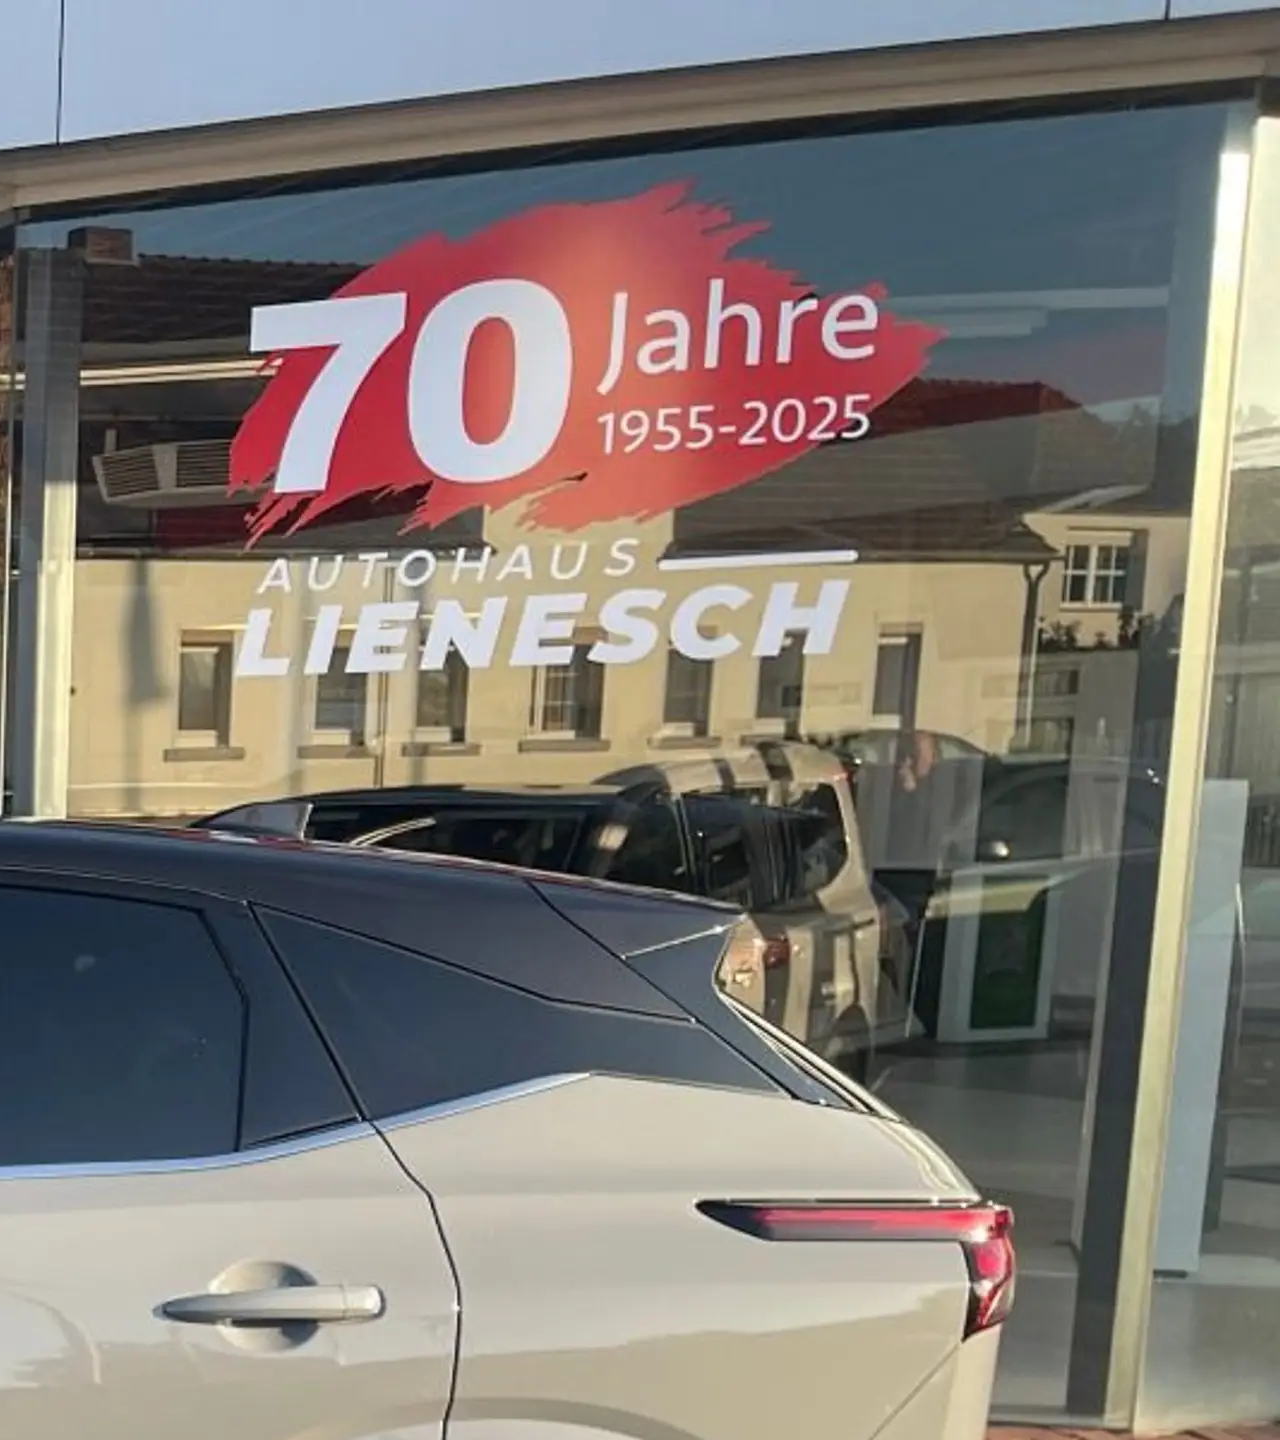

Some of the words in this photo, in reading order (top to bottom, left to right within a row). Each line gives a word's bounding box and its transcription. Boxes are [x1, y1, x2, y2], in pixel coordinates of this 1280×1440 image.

[250, 278, 572, 494] 70
[595, 278, 880, 396] Jahre
[596, 394, 871, 455] 1955-2025
[256, 538, 640, 594] AUTOHAUS
[235, 579, 851, 677] LIENESCH
